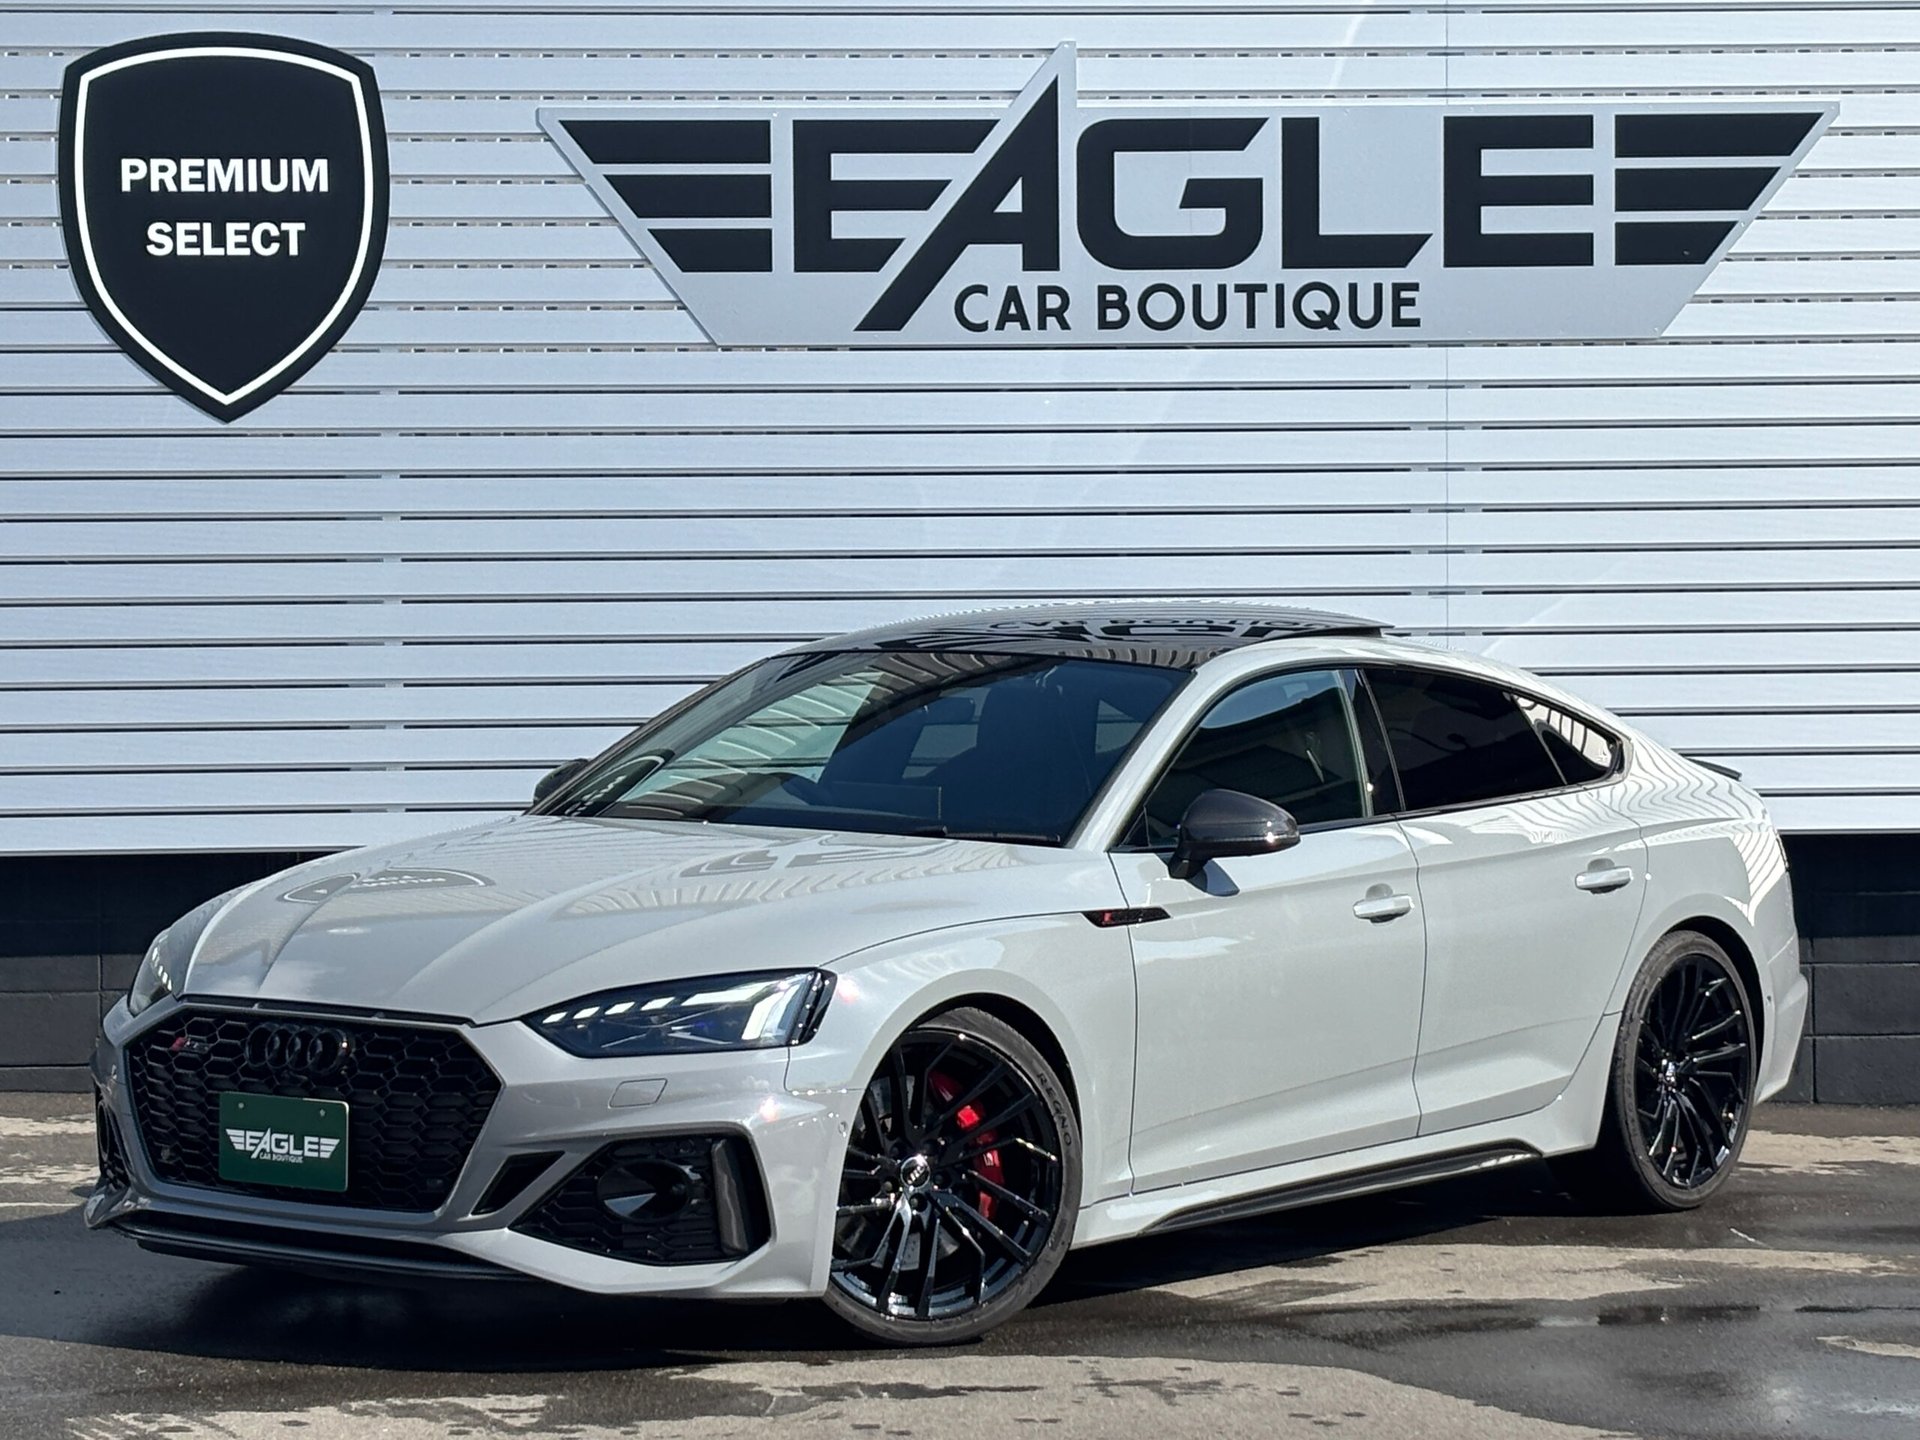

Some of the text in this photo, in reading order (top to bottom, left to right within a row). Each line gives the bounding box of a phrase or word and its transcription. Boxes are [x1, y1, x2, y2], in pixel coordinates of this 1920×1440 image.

[121, 158, 329, 193] PREMIUM
[793, 74, 1594, 331] EAGLE
[146, 221, 306, 257] SELECT
[953, 281, 1421, 333] CAR BOUTIQUE
[245, 1127, 319, 1159] EAGLE
